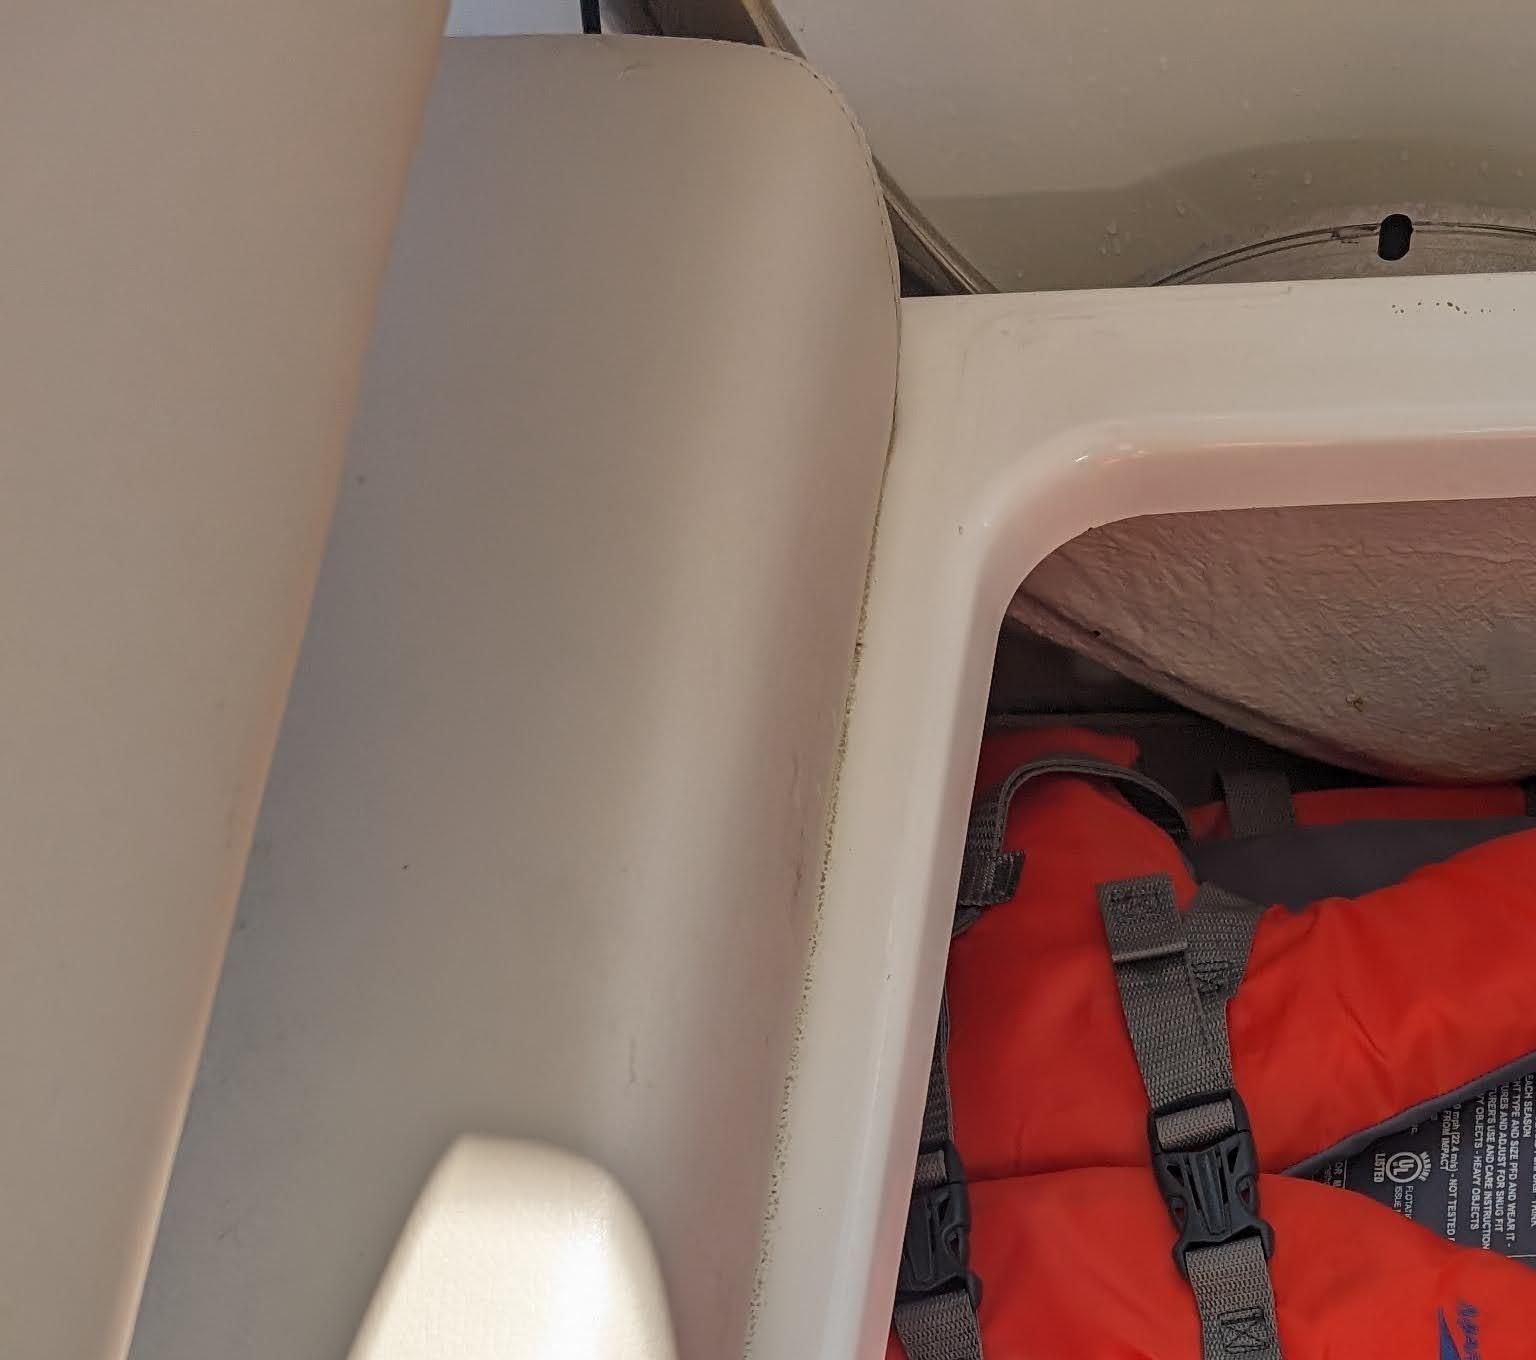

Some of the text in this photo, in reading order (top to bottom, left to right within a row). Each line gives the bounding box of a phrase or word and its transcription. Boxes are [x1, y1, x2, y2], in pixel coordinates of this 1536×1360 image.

[1451, 1112, 1460, 1129] mph
[1511, 1095, 1520, 1117] TYPE
[1523, 1101, 1532, 1137] SEASON
[1440, 1111, 1451, 1171] FROM IMPACT
[1474, 1108, 1484, 1148] OBJECTS
[1510, 1120, 1519, 1138] AND
[1484, 1126, 1496, 1189] USE AND CARE
[1509, 1141, 1519, 1160] SIZE
[1374, 1153, 1385, 1183] LISTED
[1473, 1156, 1483, 1186] HEAVY
[1495, 1112, 1508, 1232] AND ADJUST FOR SNUG FIT
[1508, 1162, 1517, 1180] PFD
[1448, 1179, 1457, 1197] NOT
[1508, 1182, 1517, 1201] AND
[1447, 1200, 1457, 1235] TESTED
[1471, 1188, 1481, 1230] OBJECTS
[1507, 1203, 1516, 1229] WEAR
